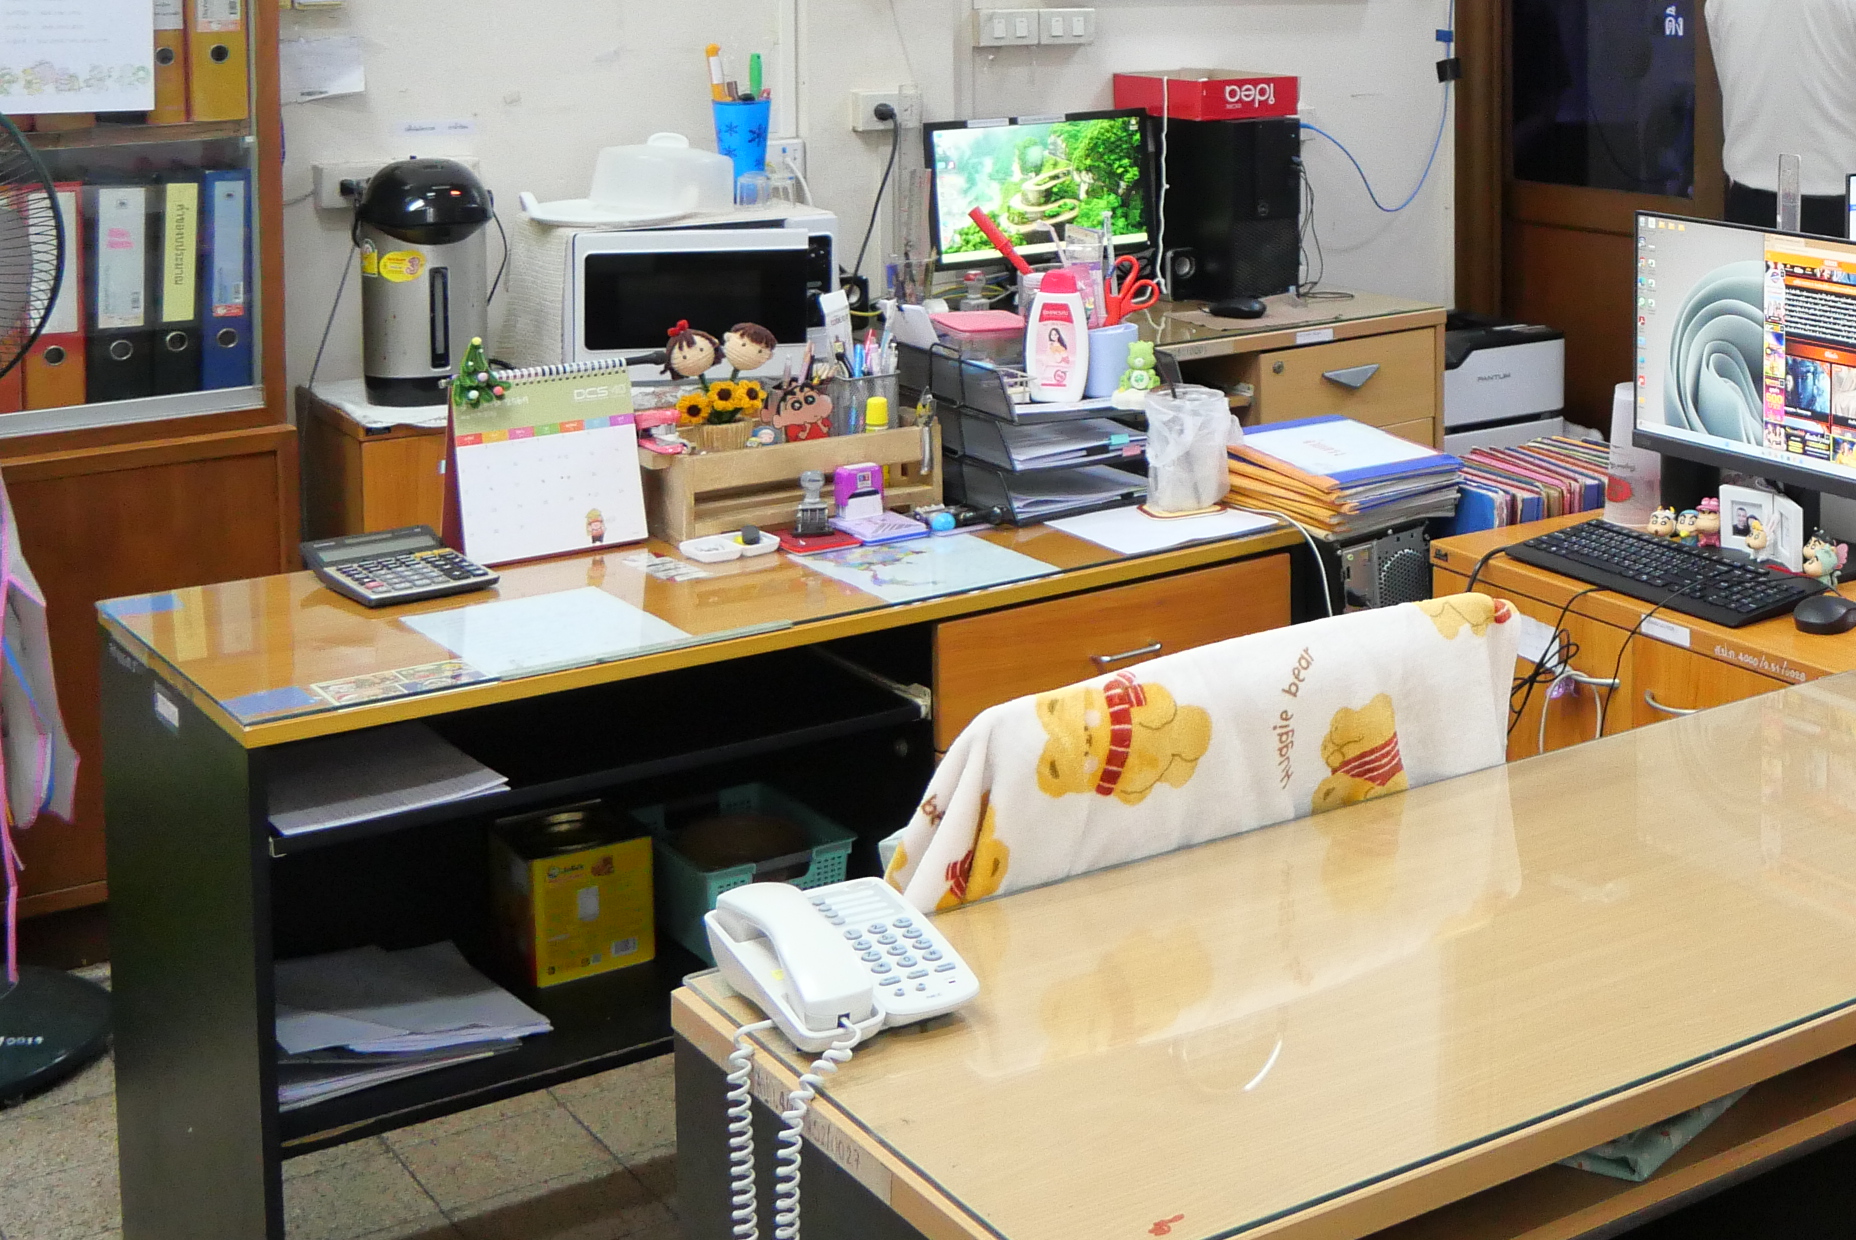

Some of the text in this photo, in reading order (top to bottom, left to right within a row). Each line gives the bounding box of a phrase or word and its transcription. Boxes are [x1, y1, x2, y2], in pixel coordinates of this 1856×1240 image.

[1664, 5, 1684, 37] ดึง
[573, 385, 609, 400] DCS
[1281, 646, 1315, 698] bear
[1272, 709, 1295, 790] Huggie
